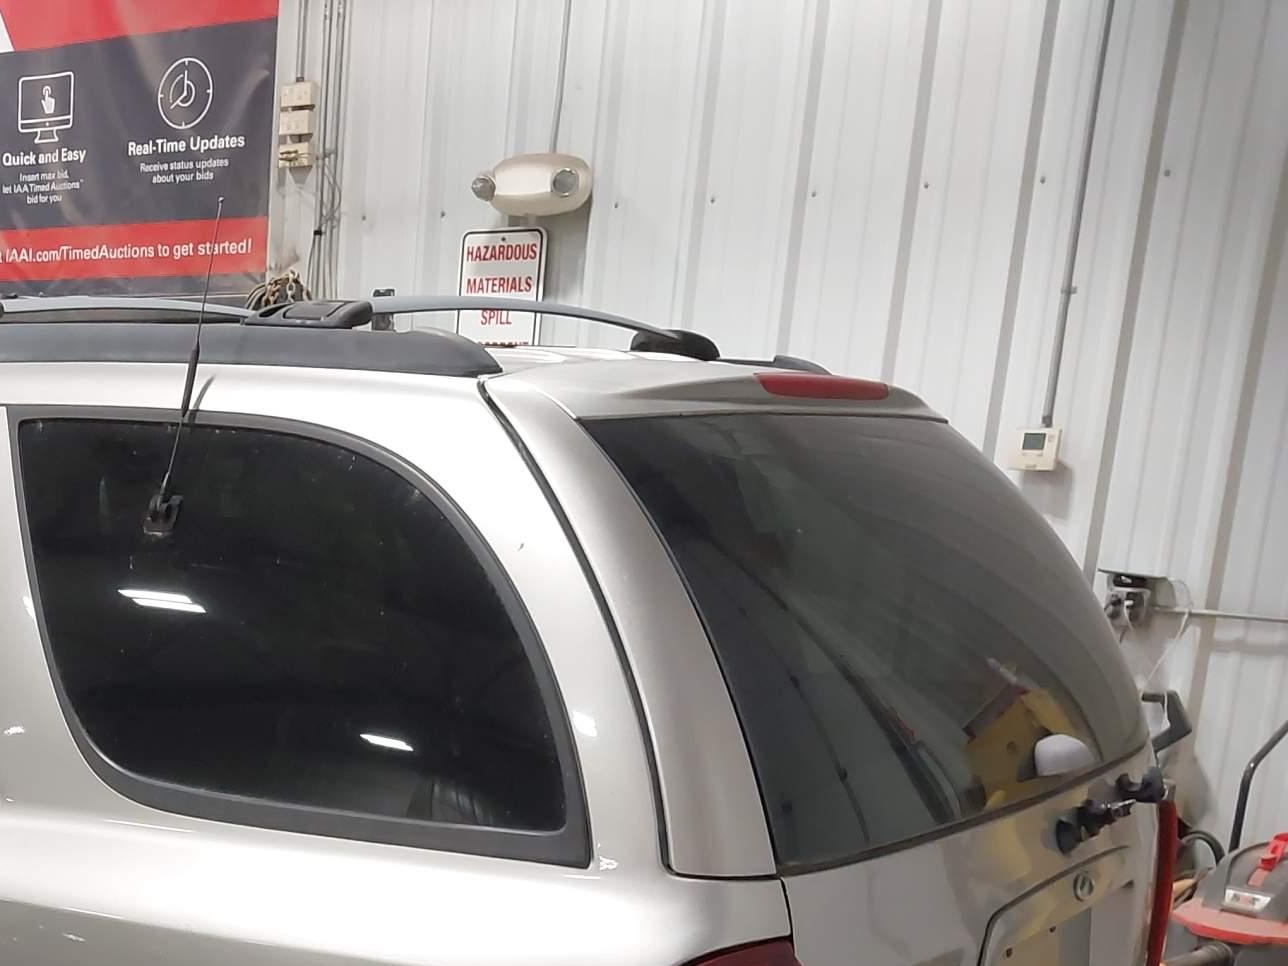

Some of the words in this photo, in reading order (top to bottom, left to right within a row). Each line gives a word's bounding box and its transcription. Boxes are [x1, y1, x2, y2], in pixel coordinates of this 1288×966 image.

[127, 138, 187, 157] Real-Time
[189, 133, 246, 152] Updates
[2, 151, 37, 167] Quick
[37, 148, 60, 165] and
[60, 147, 87, 164] Easy
[139, 162, 169, 174] Receive
[169, 161, 194, 172] status
[195, 157, 230, 171] updates
[19, 172, 40, 182] Insert
[40, 172, 57, 181] max
[152, 173, 175, 184] about
[175, 172, 194, 184] your
[195, 170, 214, 181] bids
[2, 184, 12, 194] let
[13, 183, 29, 194] IAA
[29, 181, 50, 192] Timed
[26, 193, 39, 205] bid
[39, 193, 50, 203] for
[49, 194, 63, 204] you
[4, 243, 155, 263] IAAI.com/TimedAuctions
[157, 243, 170, 257] to
[173, 244, 195, 260] get
[197, 237, 253, 256] started!
[466, 243, 538, 262] HAZARDOUS
[466, 276, 533, 294] MATERIALS
[480, 309, 512, 326] SPILL
